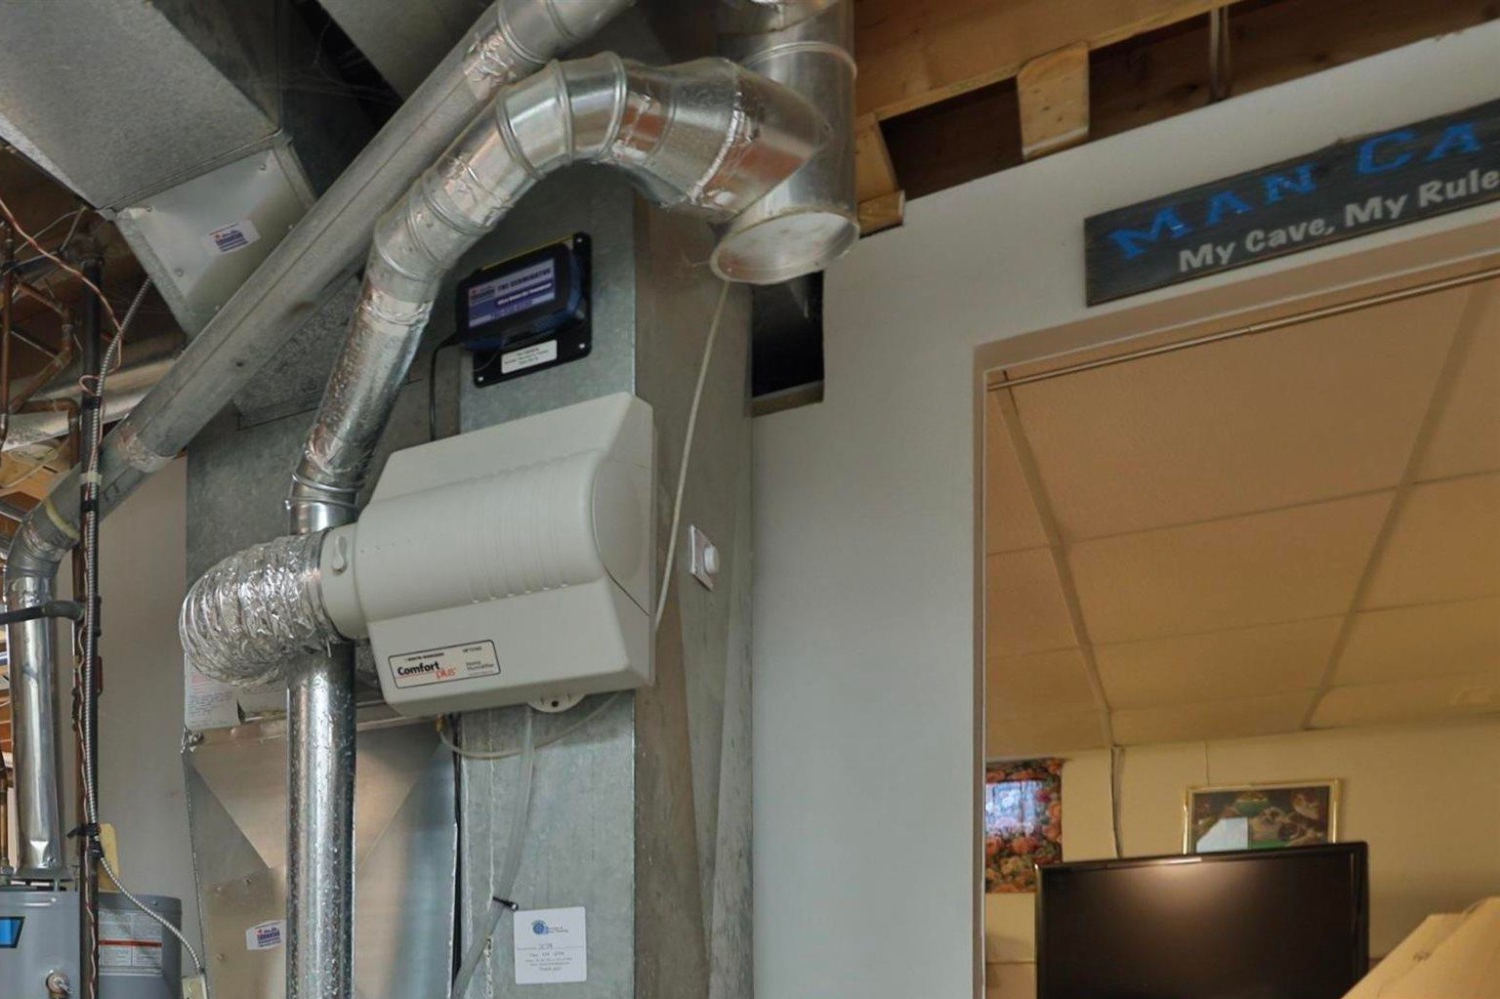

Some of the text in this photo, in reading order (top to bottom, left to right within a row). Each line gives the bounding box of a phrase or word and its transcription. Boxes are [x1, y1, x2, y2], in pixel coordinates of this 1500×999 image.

[1108, 122, 1483, 261] MAN CA
[1179, 168, 1500, 273] My Cave, My Rule
[397, 660, 440, 676] Comfort
